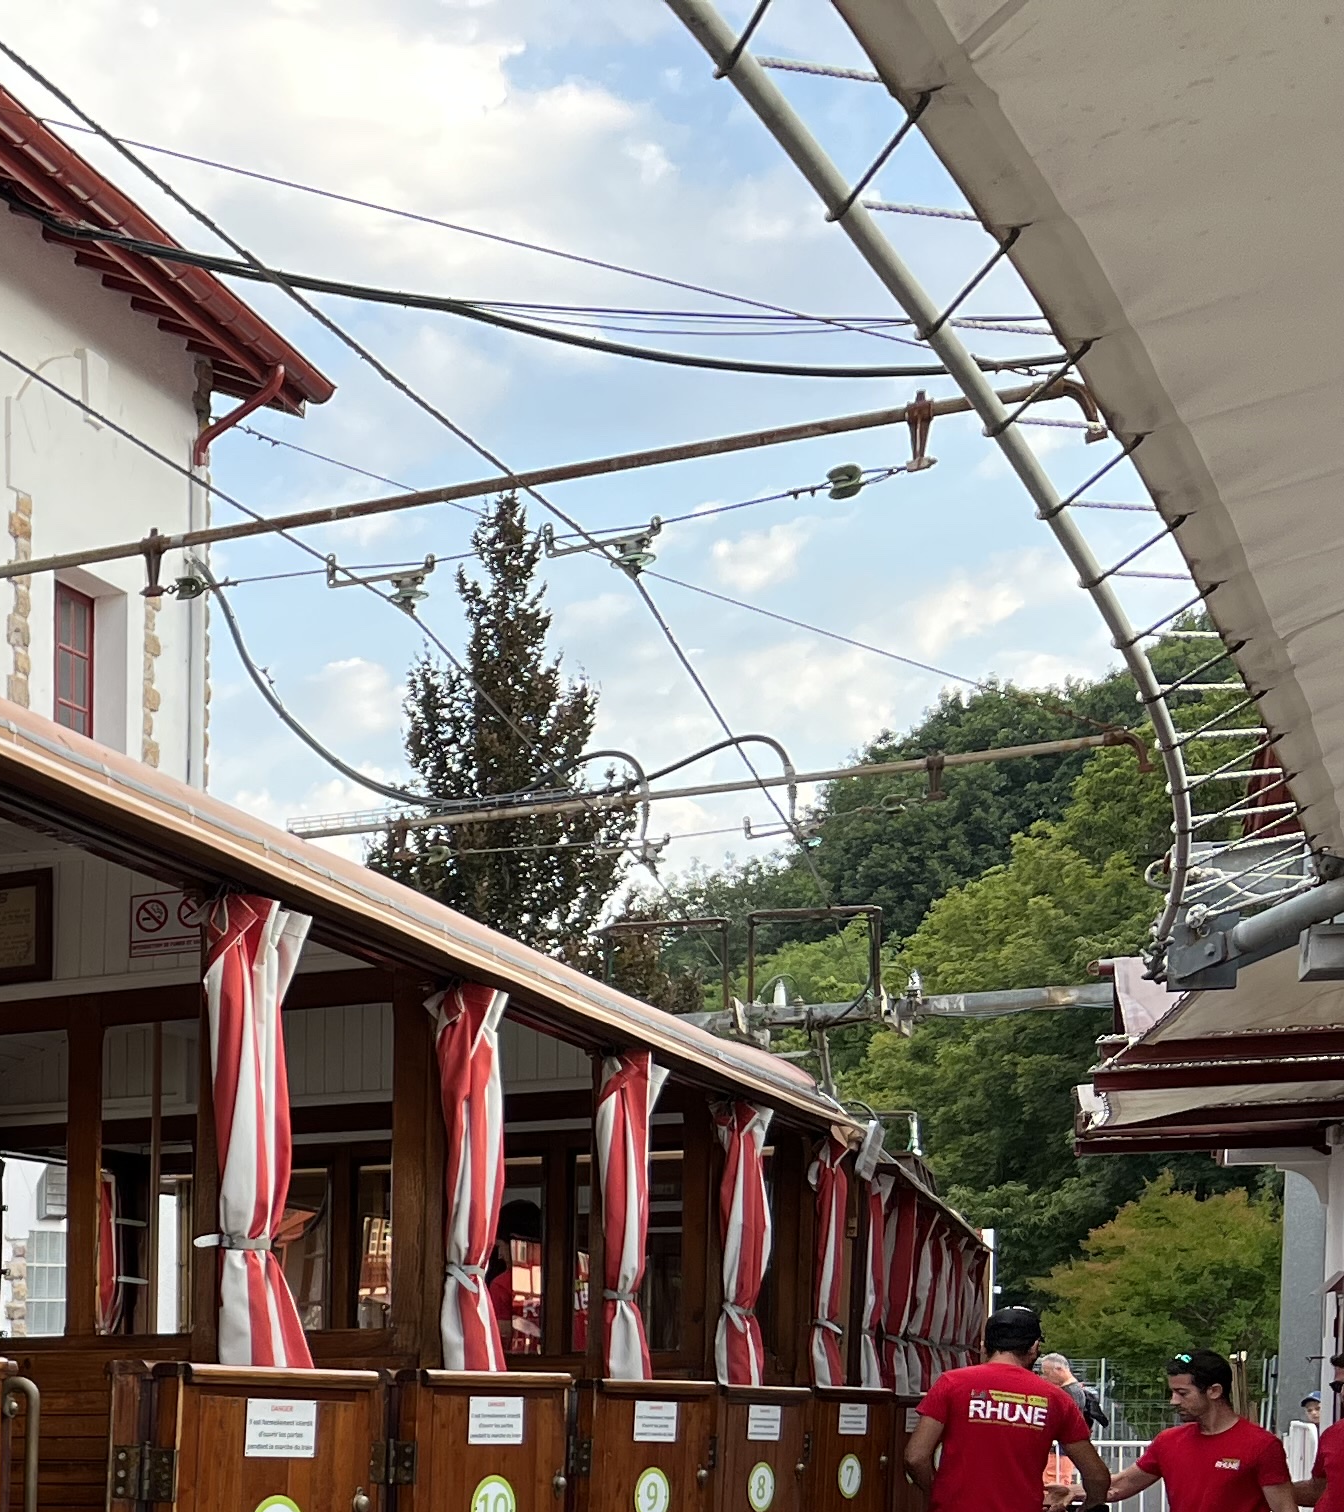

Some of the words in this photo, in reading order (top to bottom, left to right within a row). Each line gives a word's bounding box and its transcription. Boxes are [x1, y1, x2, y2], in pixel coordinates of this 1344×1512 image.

[968, 1399, 1048, 1427] RHUNE
[755, 1475, 766, 1500] 8
[845, 1465, 855, 1487] 7
[646, 1482, 658, 1512] 9
